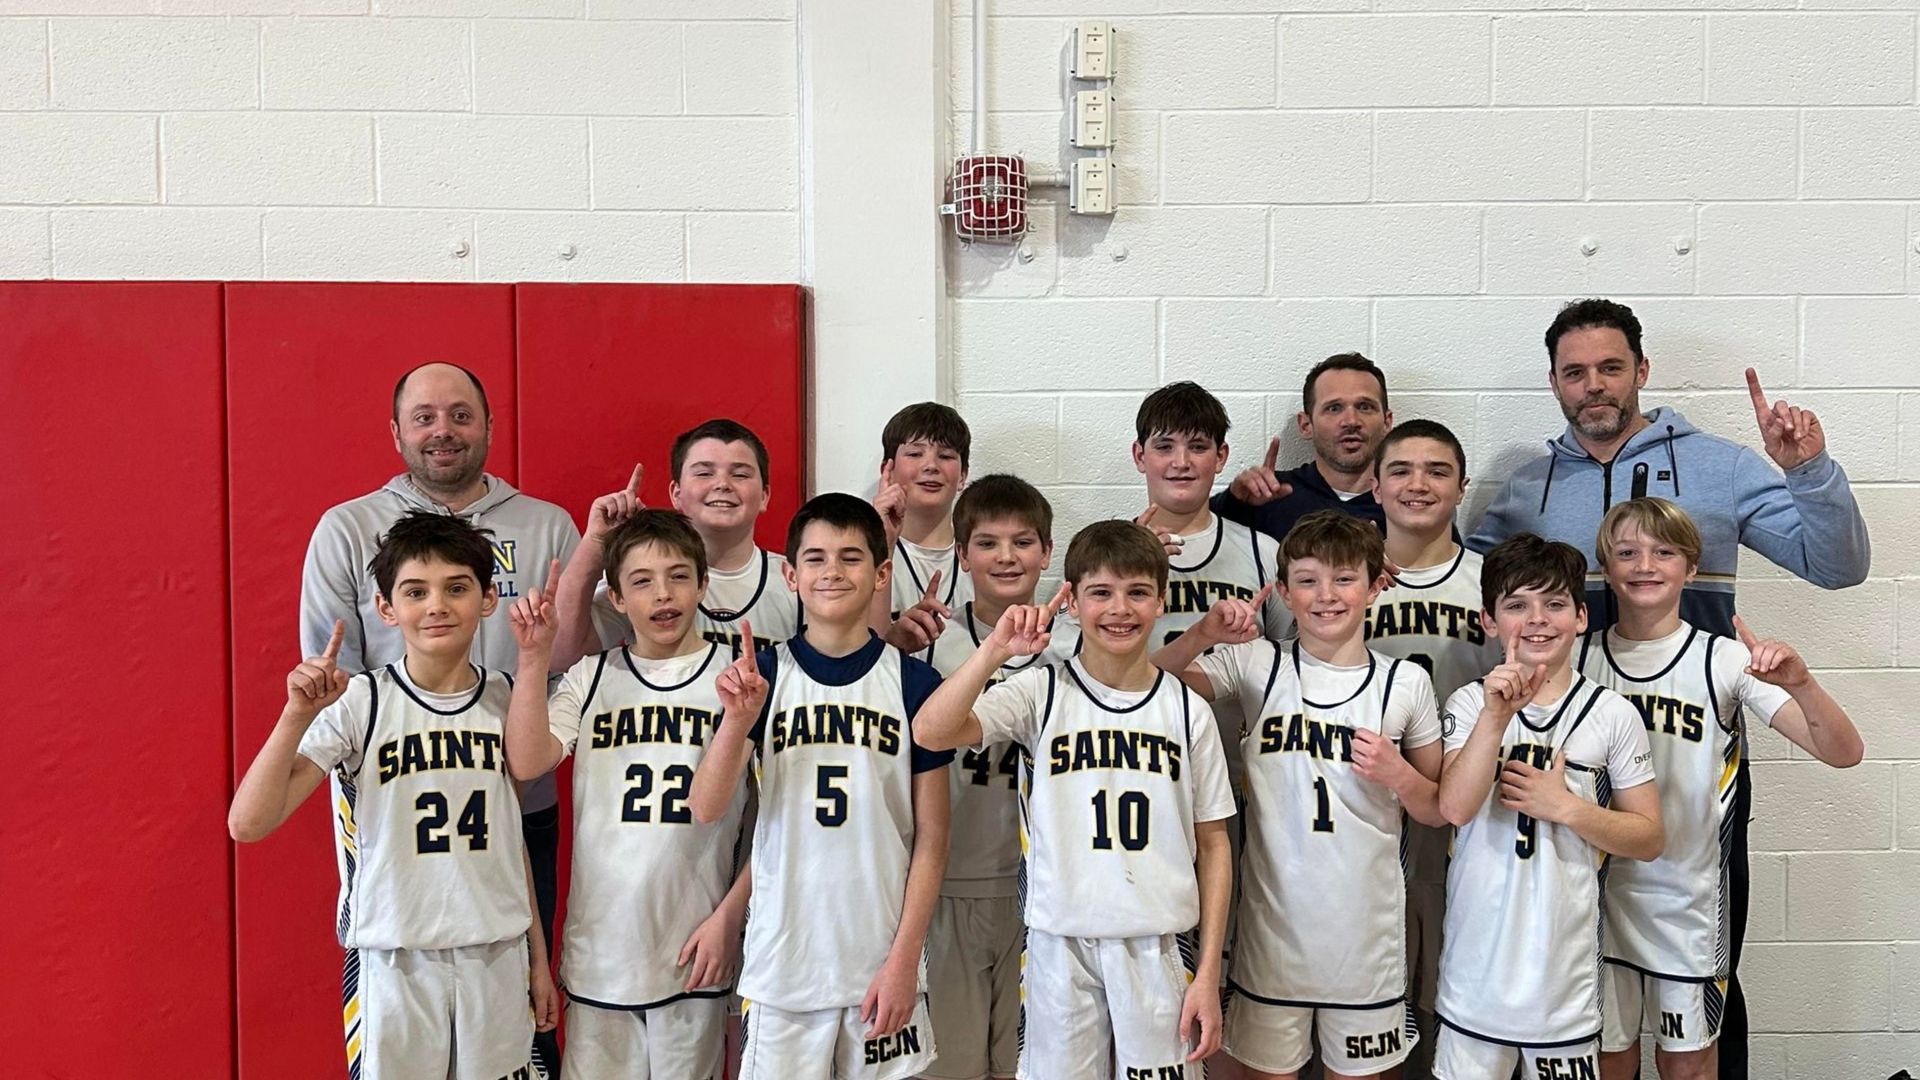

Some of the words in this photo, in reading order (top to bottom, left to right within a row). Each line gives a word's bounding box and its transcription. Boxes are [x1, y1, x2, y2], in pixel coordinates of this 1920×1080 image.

[378, 730, 506, 785] SAINT
[772, 704, 900, 756] SAINTS
[1050, 730, 1182, 782] SAINTS
[621, 763, 694, 824] 22
[815, 765, 848, 827] 5
[1091, 789, 1150, 851] 10
[1312, 775, 1335, 833] 1
[415, 789, 489, 855] 24
[864, 1025, 921, 1066] SCJN
[1346, 1026, 1402, 1059] SCJN
[1535, 1055, 1596, 1080] SCJN
